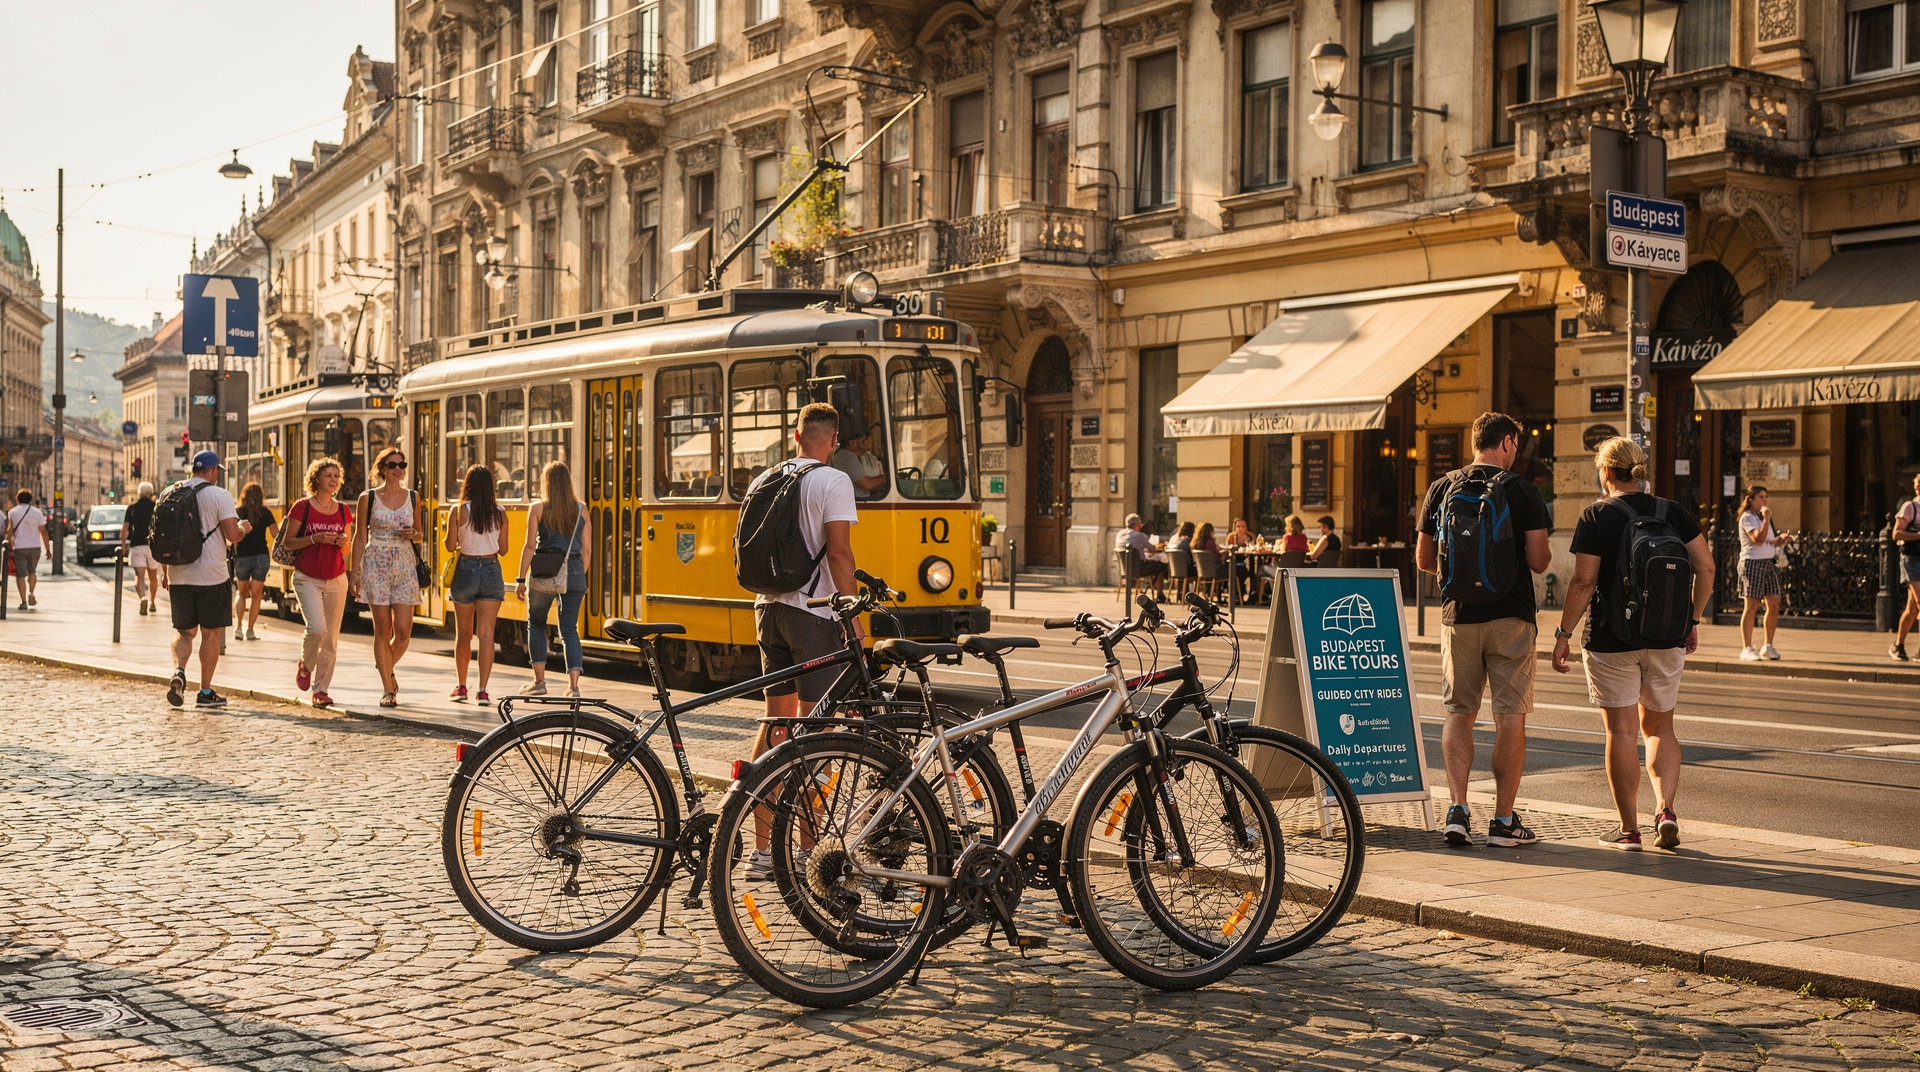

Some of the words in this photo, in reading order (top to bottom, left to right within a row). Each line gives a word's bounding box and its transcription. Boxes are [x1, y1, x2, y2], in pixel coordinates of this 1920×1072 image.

[1612, 198, 1680, 228] Budapest
[1810, 374, 1880, 402] Kávézó
[1248, 412, 1294, 431] Kávézó
[1321, 639, 1386, 653] BUDAPEST
[1312, 655, 1347, 670] BIKE
[1350, 654, 1399, 670] TOURS
[1317, 690, 1352, 700] GUIDED
[1354, 689, 1374, 699] CITY
[1377, 688, 1403, 699] RIDES
[1327, 744, 1351, 756] Daily
[1354, 743, 1407, 756] Departures
